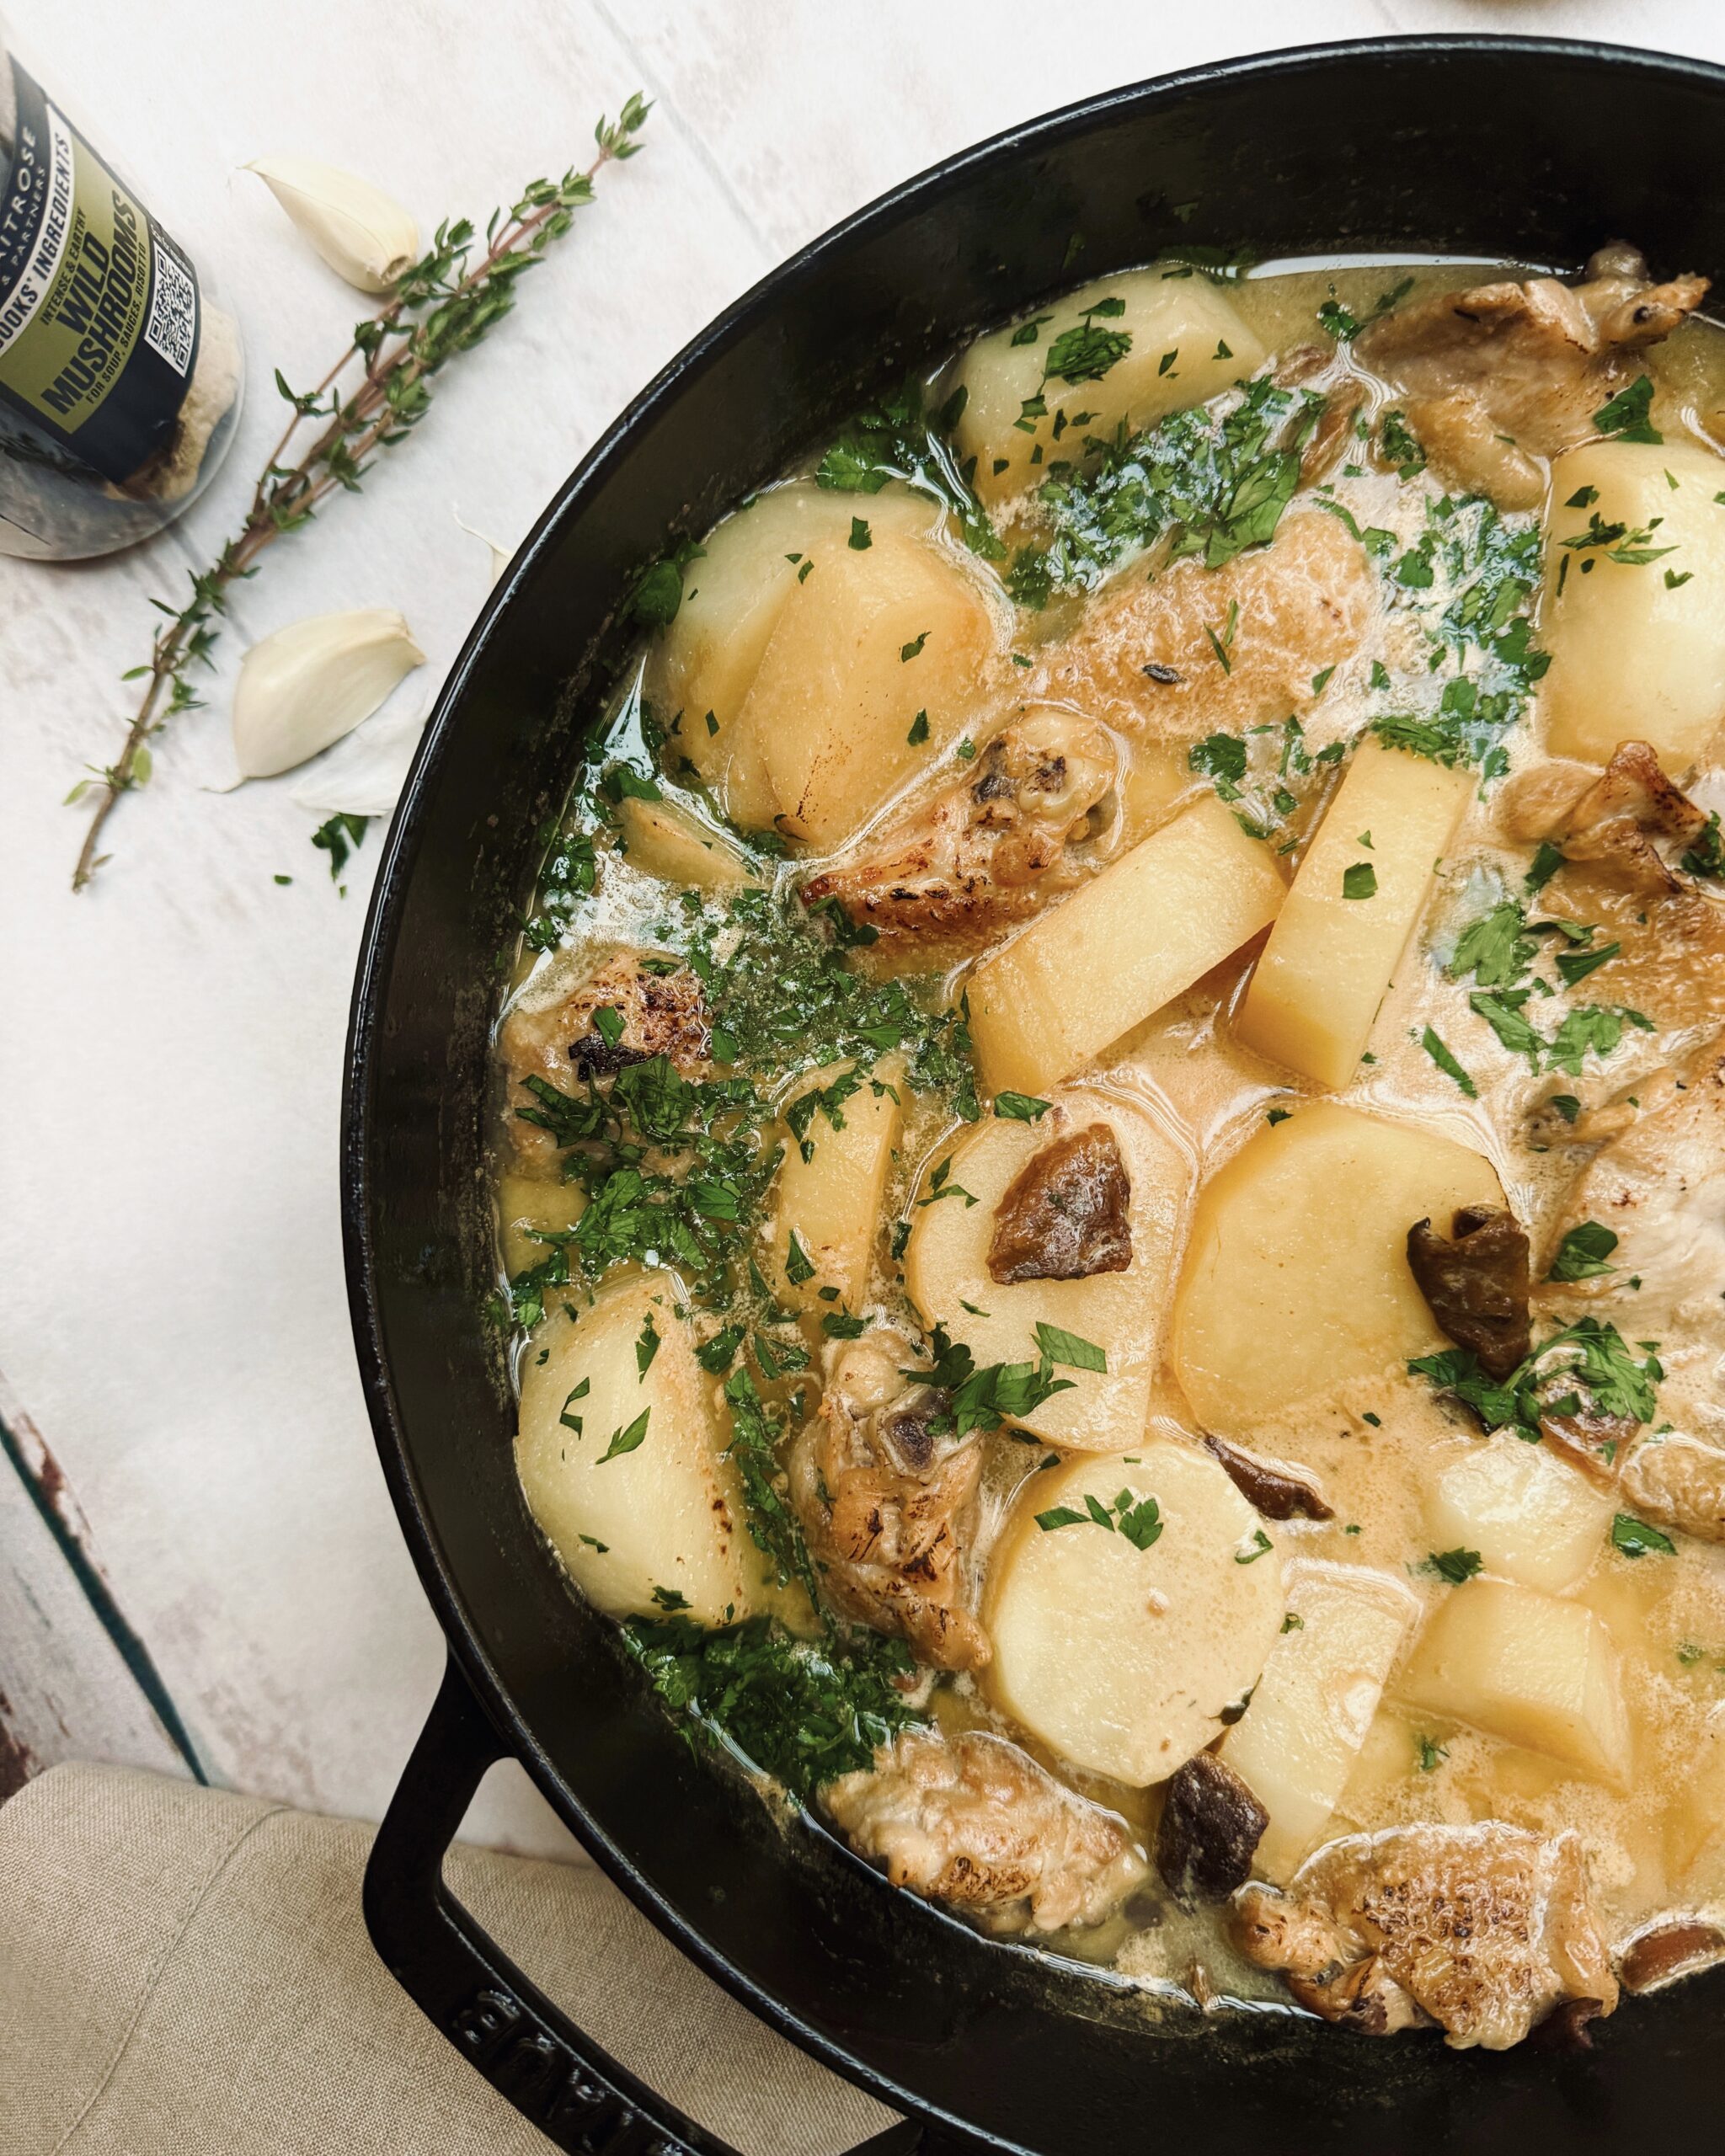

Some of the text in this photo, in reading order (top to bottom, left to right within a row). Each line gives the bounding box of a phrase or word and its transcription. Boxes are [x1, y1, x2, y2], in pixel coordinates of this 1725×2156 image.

[0, 132, 71, 348] OOKS' INGREDIENTS
[10, 167, 45, 266] PARTNERS
[40, 206, 86, 326] INTENSE & EARTHY
[56, 232, 109, 335] WILD
[40, 189, 137, 415] MUSHROOMS
[86, 382, 104, 404] FOR
[136, 242, 147, 297] RISOTTO
